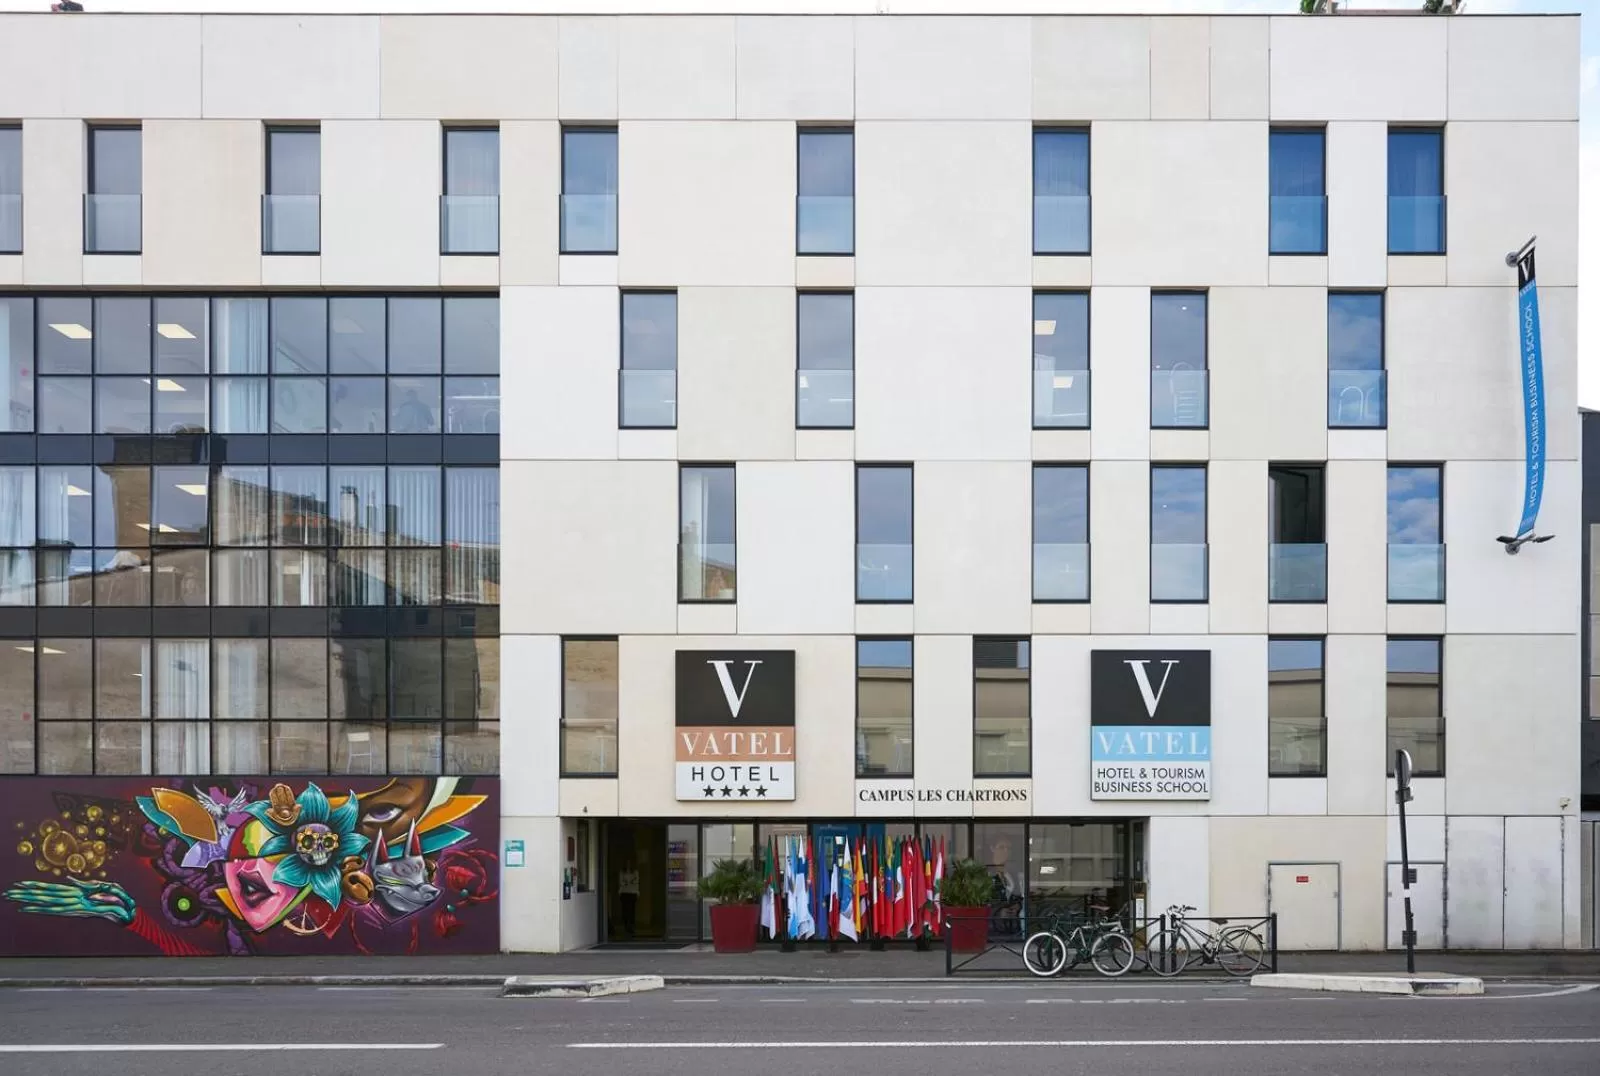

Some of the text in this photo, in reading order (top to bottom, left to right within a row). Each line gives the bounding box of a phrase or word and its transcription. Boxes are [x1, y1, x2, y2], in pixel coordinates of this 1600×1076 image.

[1520, 252, 1533, 281] V
[1524, 301, 1535, 352] SCHOOL
[1527, 353, 1538, 408] BUSINESS
[1531, 409, 1540, 460] TOURISM
[1529, 471, 1539, 508] HOTEL
[706, 660, 764, 718] V
[1123, 659, 1180, 718] V
[681, 731, 792, 756] VATEL
[1098, 731, 1208, 756] VATEL
[691, 766, 780, 782] HOTEL
[1094, 781, 1209, 793] BUSINESS SCHOOL
[1097, 767, 1205, 779] HOTEL & TOURISM
[859, 788, 1027, 802] CAMPUS LES CHARTRONS
